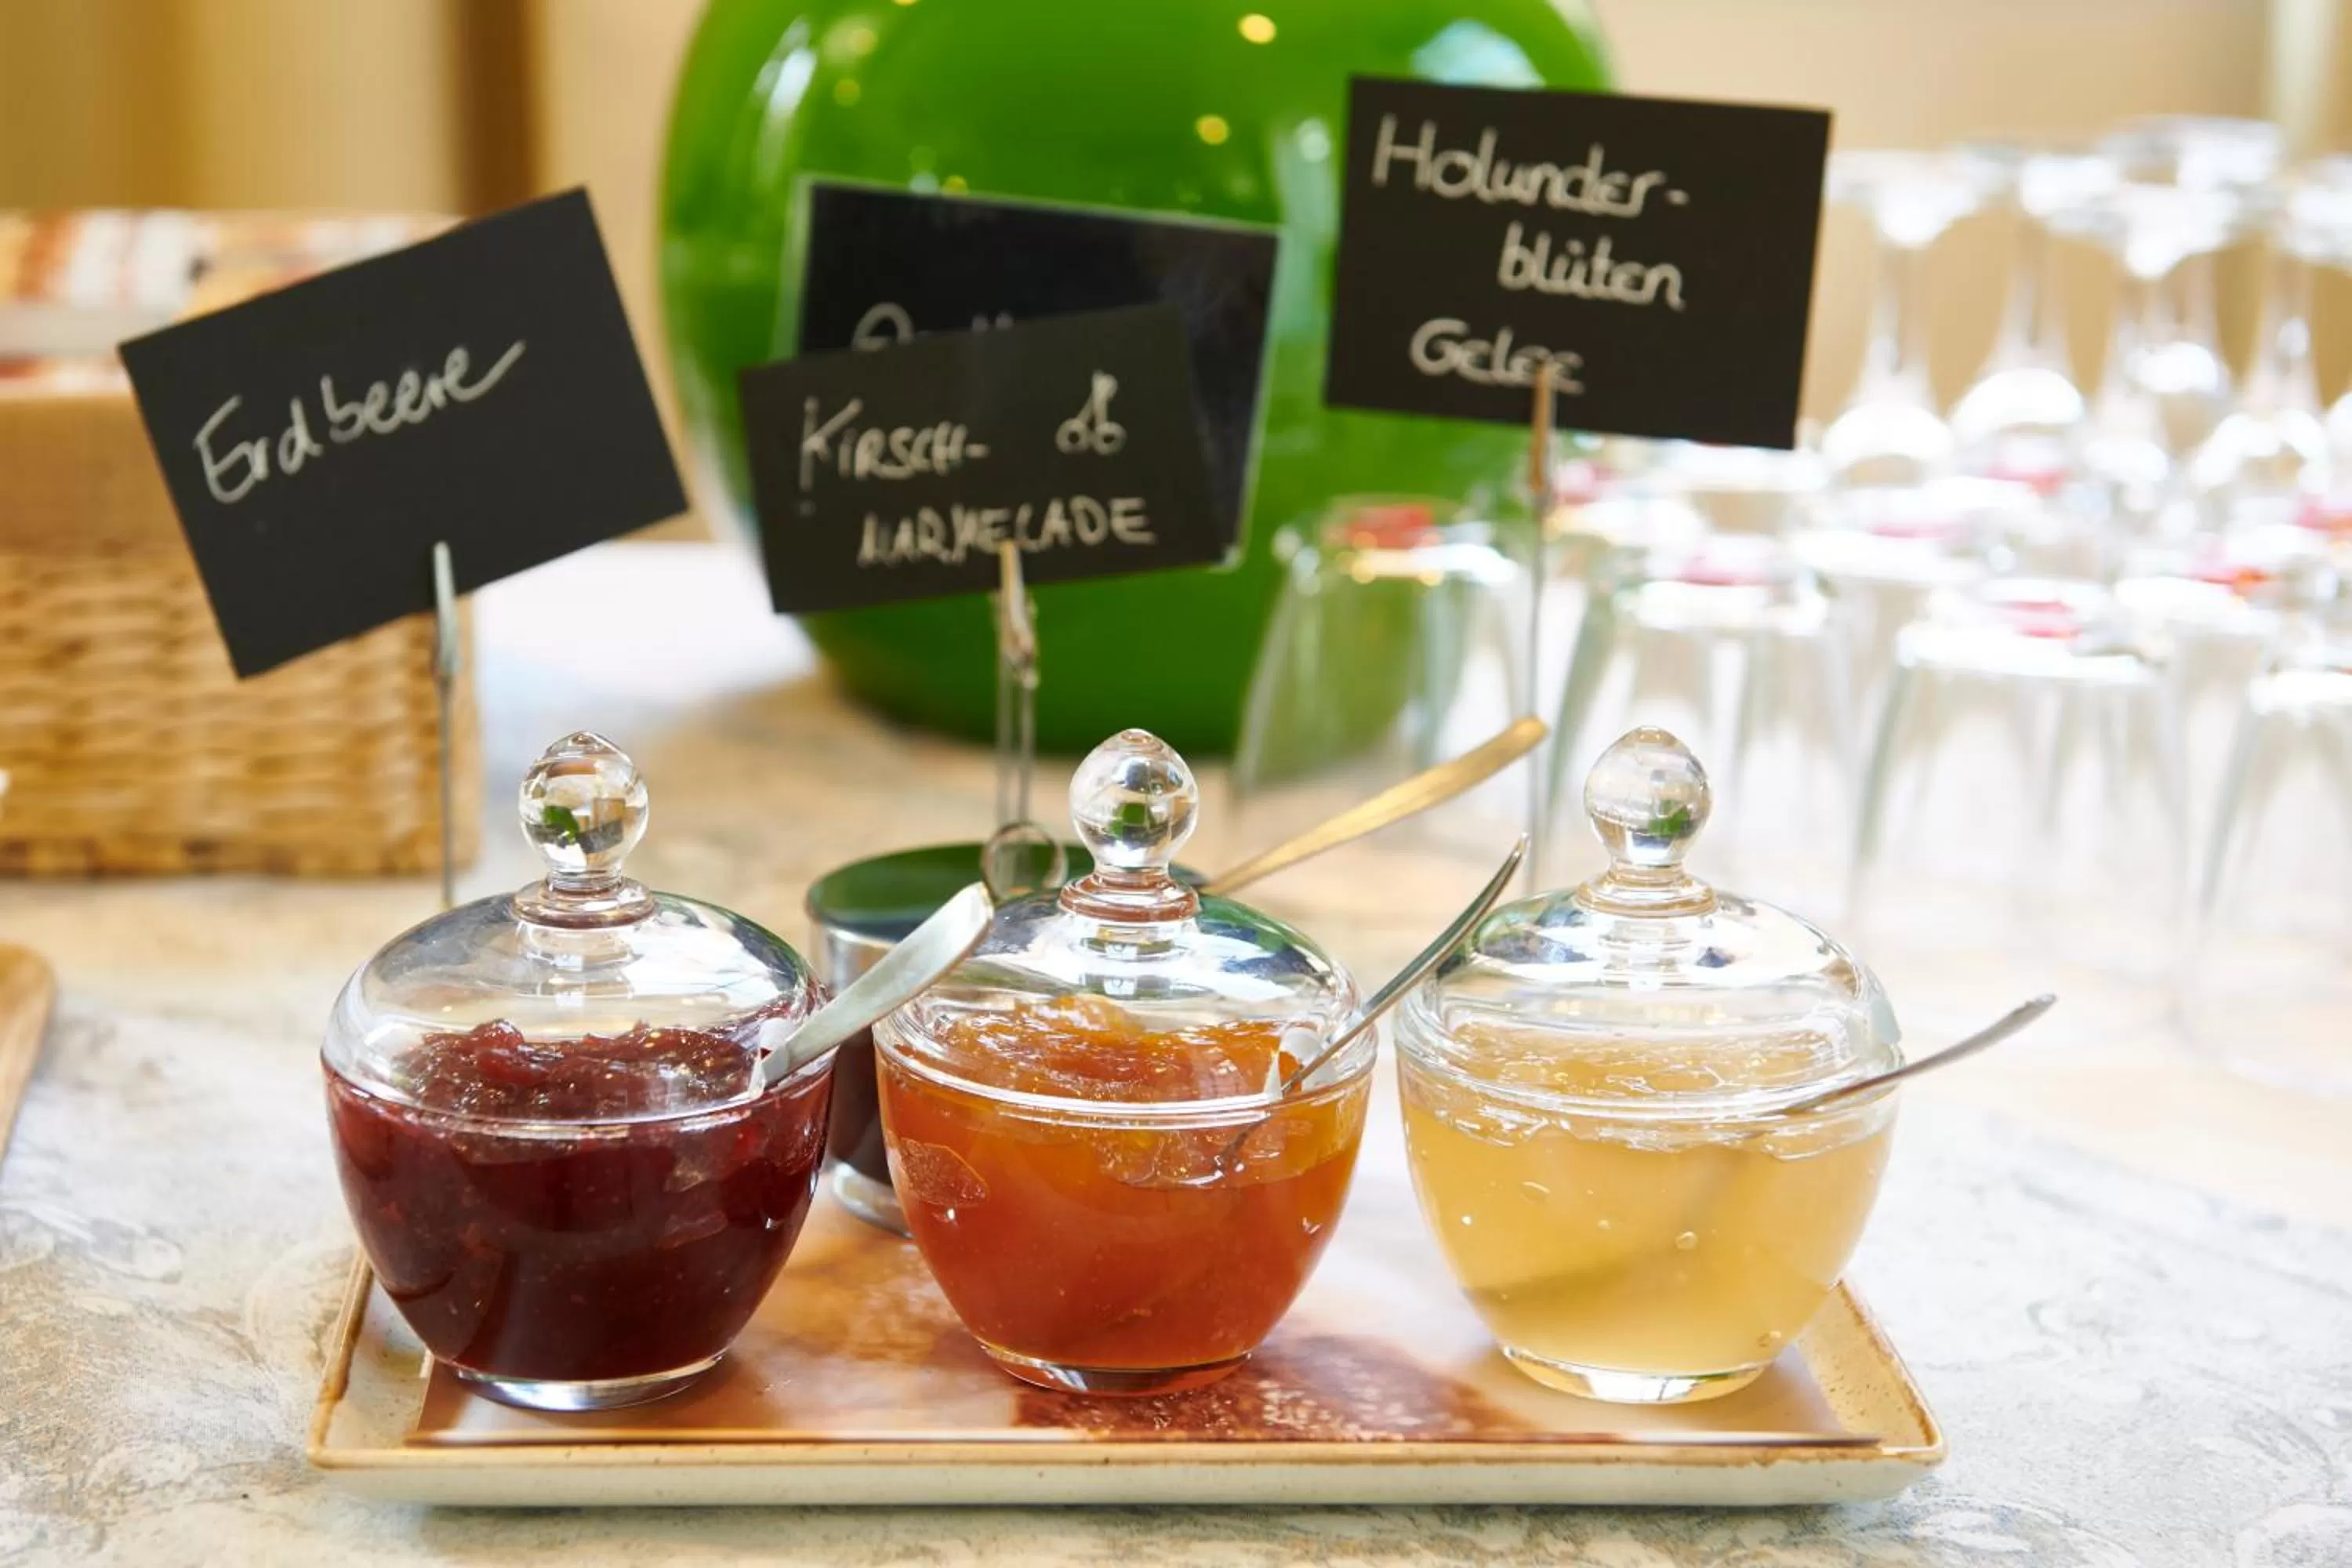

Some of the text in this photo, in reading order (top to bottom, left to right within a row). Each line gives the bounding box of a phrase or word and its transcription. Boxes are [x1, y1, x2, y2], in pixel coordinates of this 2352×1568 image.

[1370, 113, 1690, 218] Holunder-
[1497, 220, 1686, 311] blüten
[1409, 318, 1586, 396] Gelee
[194, 339, 526, 504] Erdbeere
